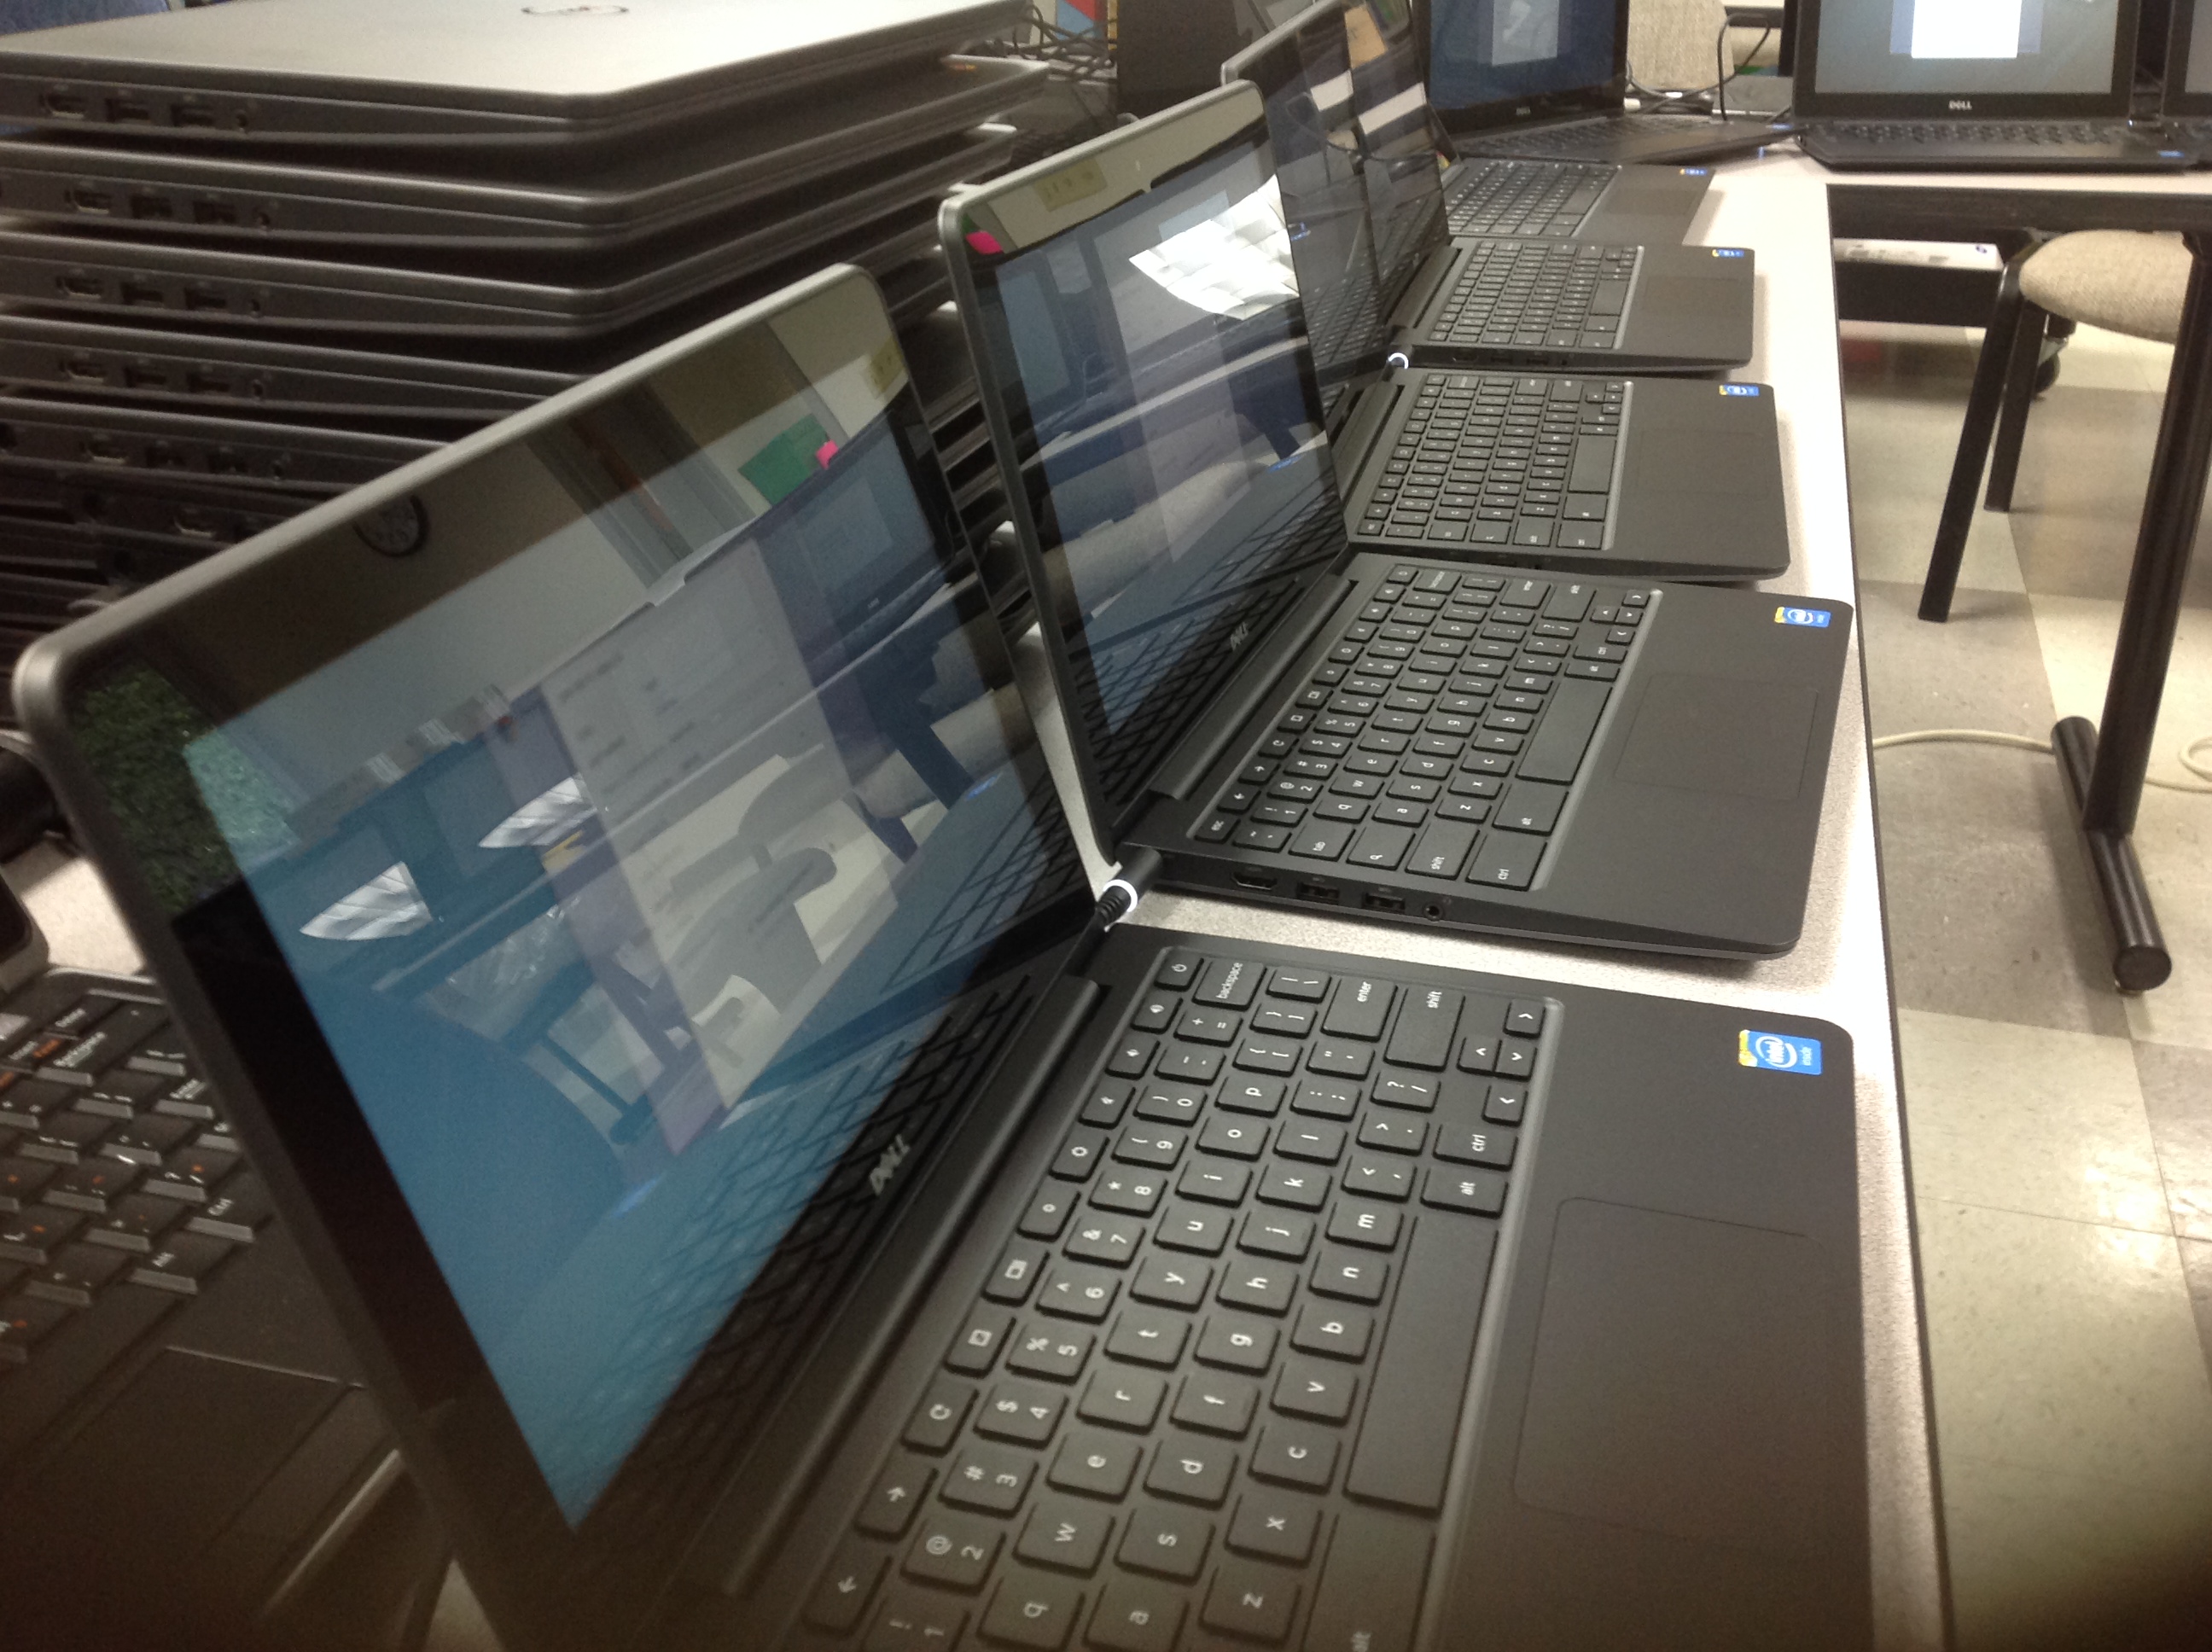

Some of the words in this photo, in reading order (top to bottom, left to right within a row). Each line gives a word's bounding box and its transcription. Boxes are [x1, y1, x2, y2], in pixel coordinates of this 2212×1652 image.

[1948, 100, 1972, 111] DELL
[1215, 962, 1243, 999] backspace
[1357, 981, 1371, 1003] enter
[1426, 991, 1442, 1009] shift
[1245, 1087, 1262, 1096] p
[1177, 1098, 1194, 1107] 0
[1227, 1129, 1243, 1138] o
[1156, 1140, 1173, 1149] 9
[1471, 1133, 1487, 1152] ctrl
[1284, 1178, 1304, 1188] k
[1458, 1181, 1476, 1195] alt
[1134, 1185, 1152, 1195] 8
[1187, 1220, 1204, 1231] u
[1357, 1213, 1376, 1229] m
[1265, 1226, 1290, 1236] j
[1110, 1234, 1127, 1244] 7
[1164, 1271, 1185, 1285] y
[1342, 1266, 1360, 1279] n
[1246, 1277, 1268, 1289] h
[1085, 1287, 1104, 1299] 6
[1138, 1329, 1159, 1338] t
[1320, 1321, 1344, 1335] b
[1230, 1333, 1254, 1347] g
[1057, 1344, 1078, 1357] 5
[1307, 1381, 1325, 1393] v
[1115, 1390, 1131, 1401] r
[1203, 1394, 1225, 1405] f
[1029, 1406, 1050, 1419] 4
[1288, 1446, 1307, 1459] c
[1087, 1455, 1106, 1468] e
[1180, 1458, 1203, 1475] d
[996, 1474, 1018, 1486] 3
[1266, 1515, 1286, 1531] x
[1055, 1522, 1076, 1542] w
[1157, 1533, 1178, 1546] s
[961, 1545, 984, 1560] 2
[1243, 1592, 1263, 1608] z
[1023, 1601, 1048, 1618] q
[1129, 1610, 1150, 1625] a
[924, 1626, 944, 1637] 1
